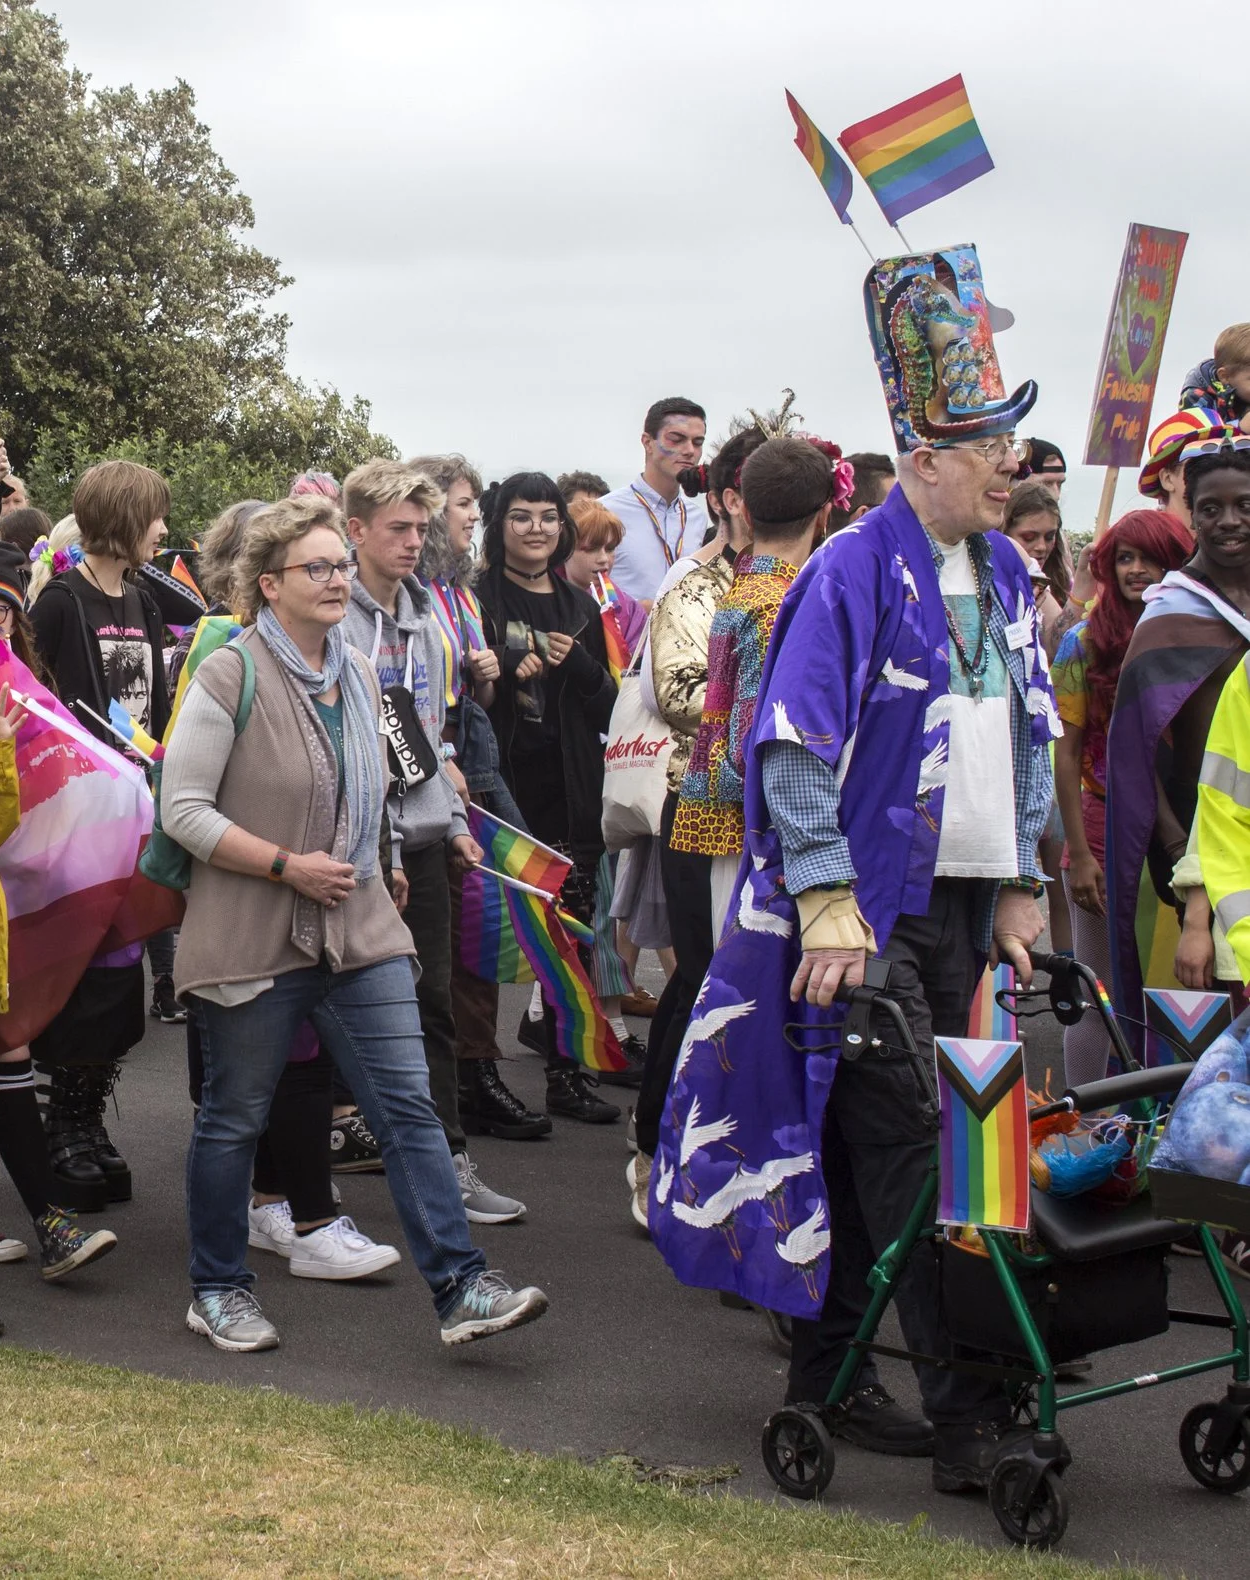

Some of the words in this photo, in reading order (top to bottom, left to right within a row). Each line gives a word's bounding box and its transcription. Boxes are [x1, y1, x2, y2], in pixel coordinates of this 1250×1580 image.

[1110, 413, 1141, 441] Pride
[382, 699, 421, 775] adidas
[629, 760, 655, 768] MAGAZINE
